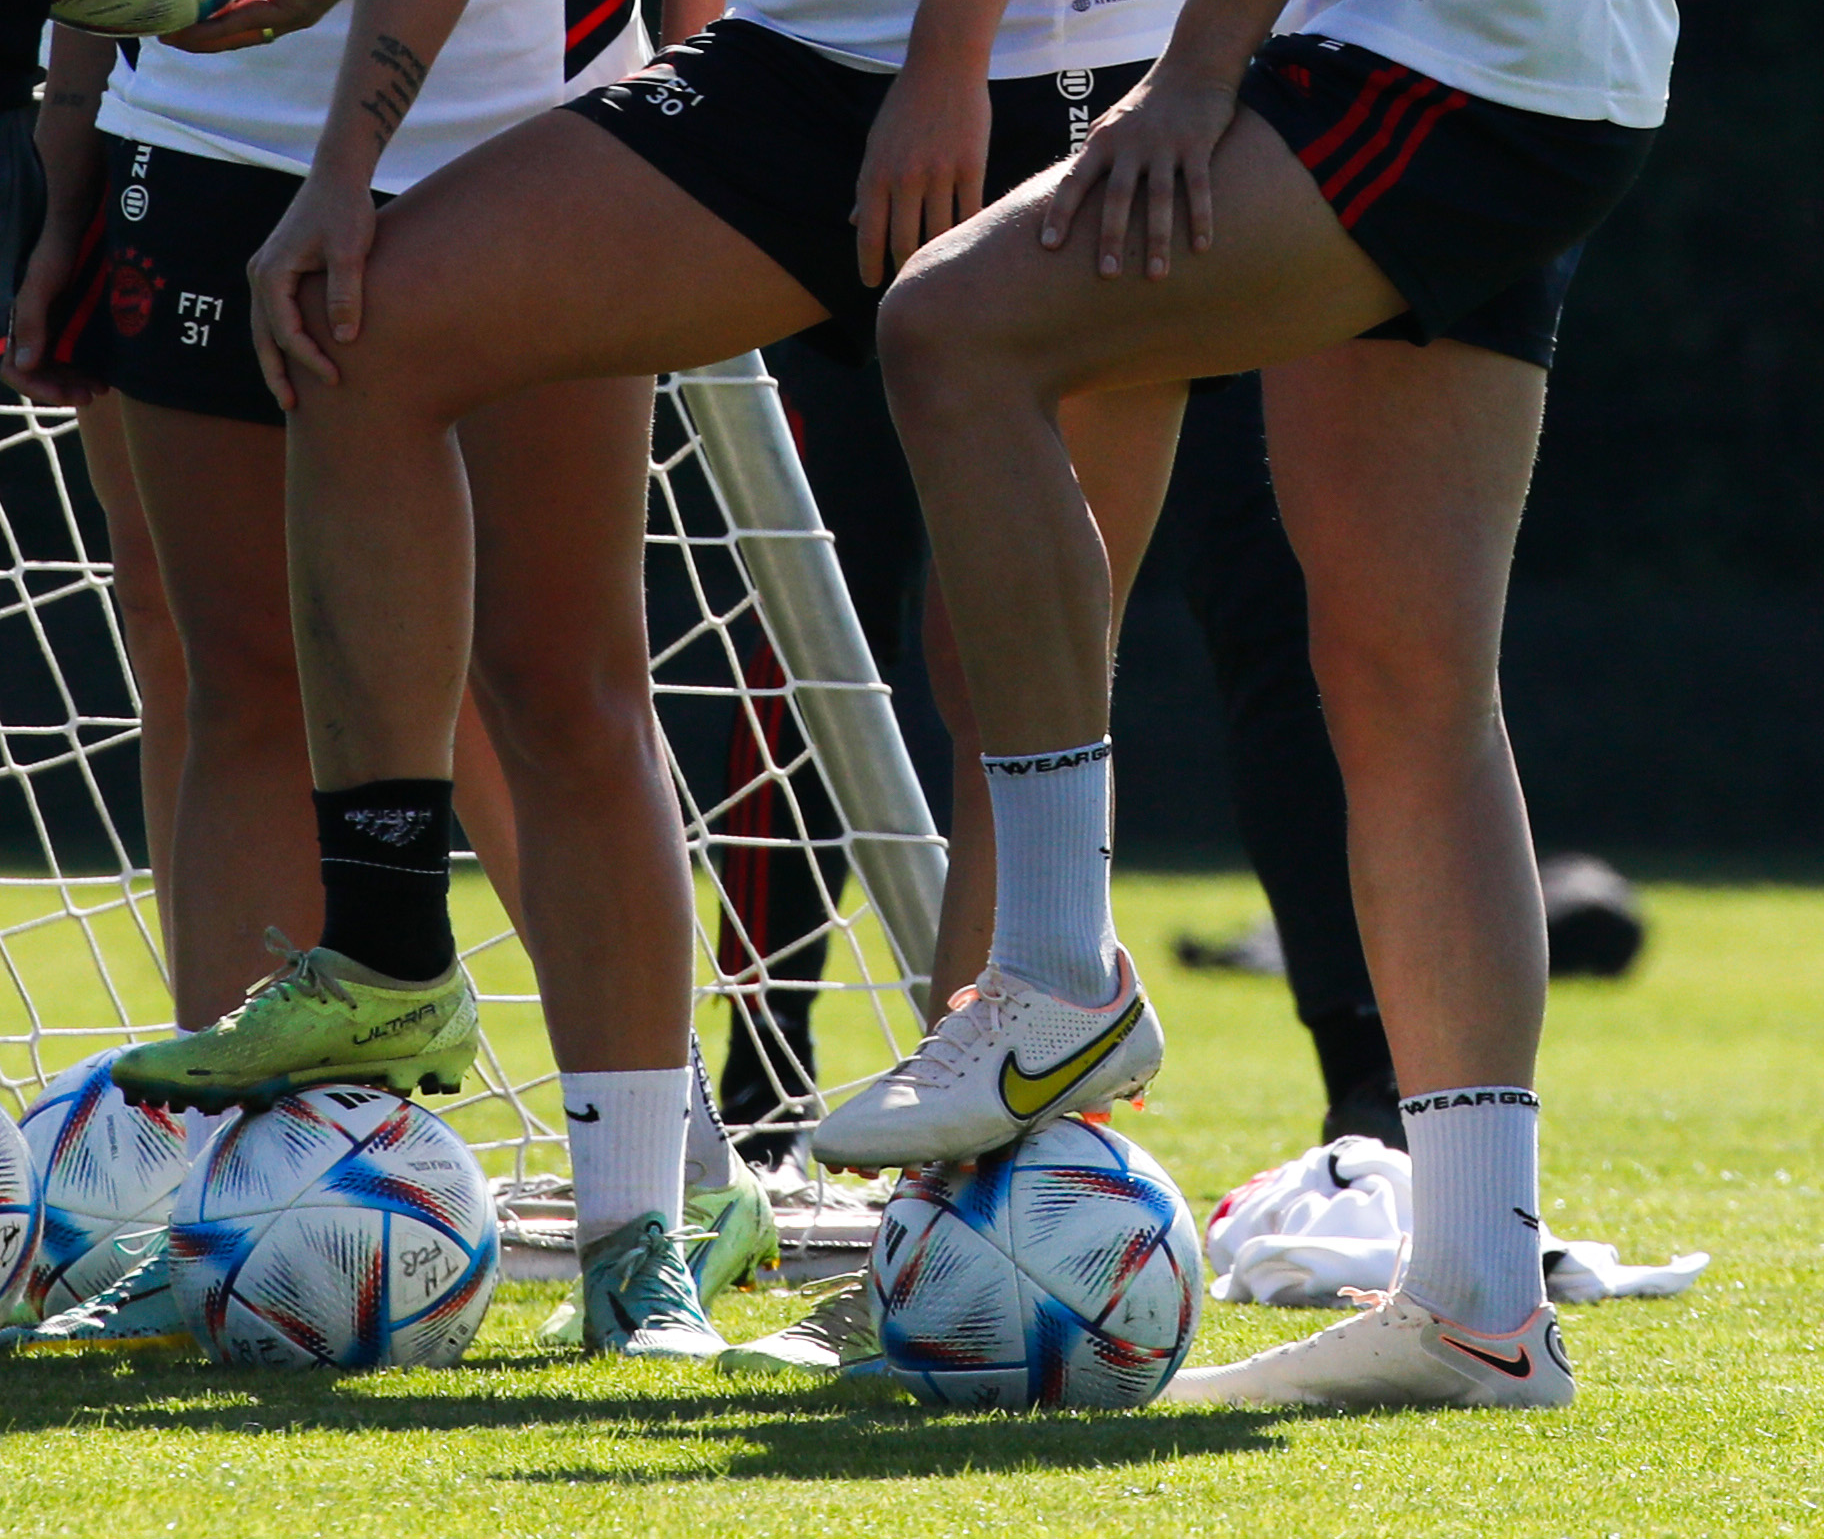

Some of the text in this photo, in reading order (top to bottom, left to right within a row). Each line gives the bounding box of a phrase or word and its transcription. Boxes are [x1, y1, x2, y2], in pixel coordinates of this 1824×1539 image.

[644, 86, 685, 117] 30
[177, 291, 224, 321] FF1
[180, 320, 210, 347] 31
[352, 1003, 437, 1046] ULTRA
